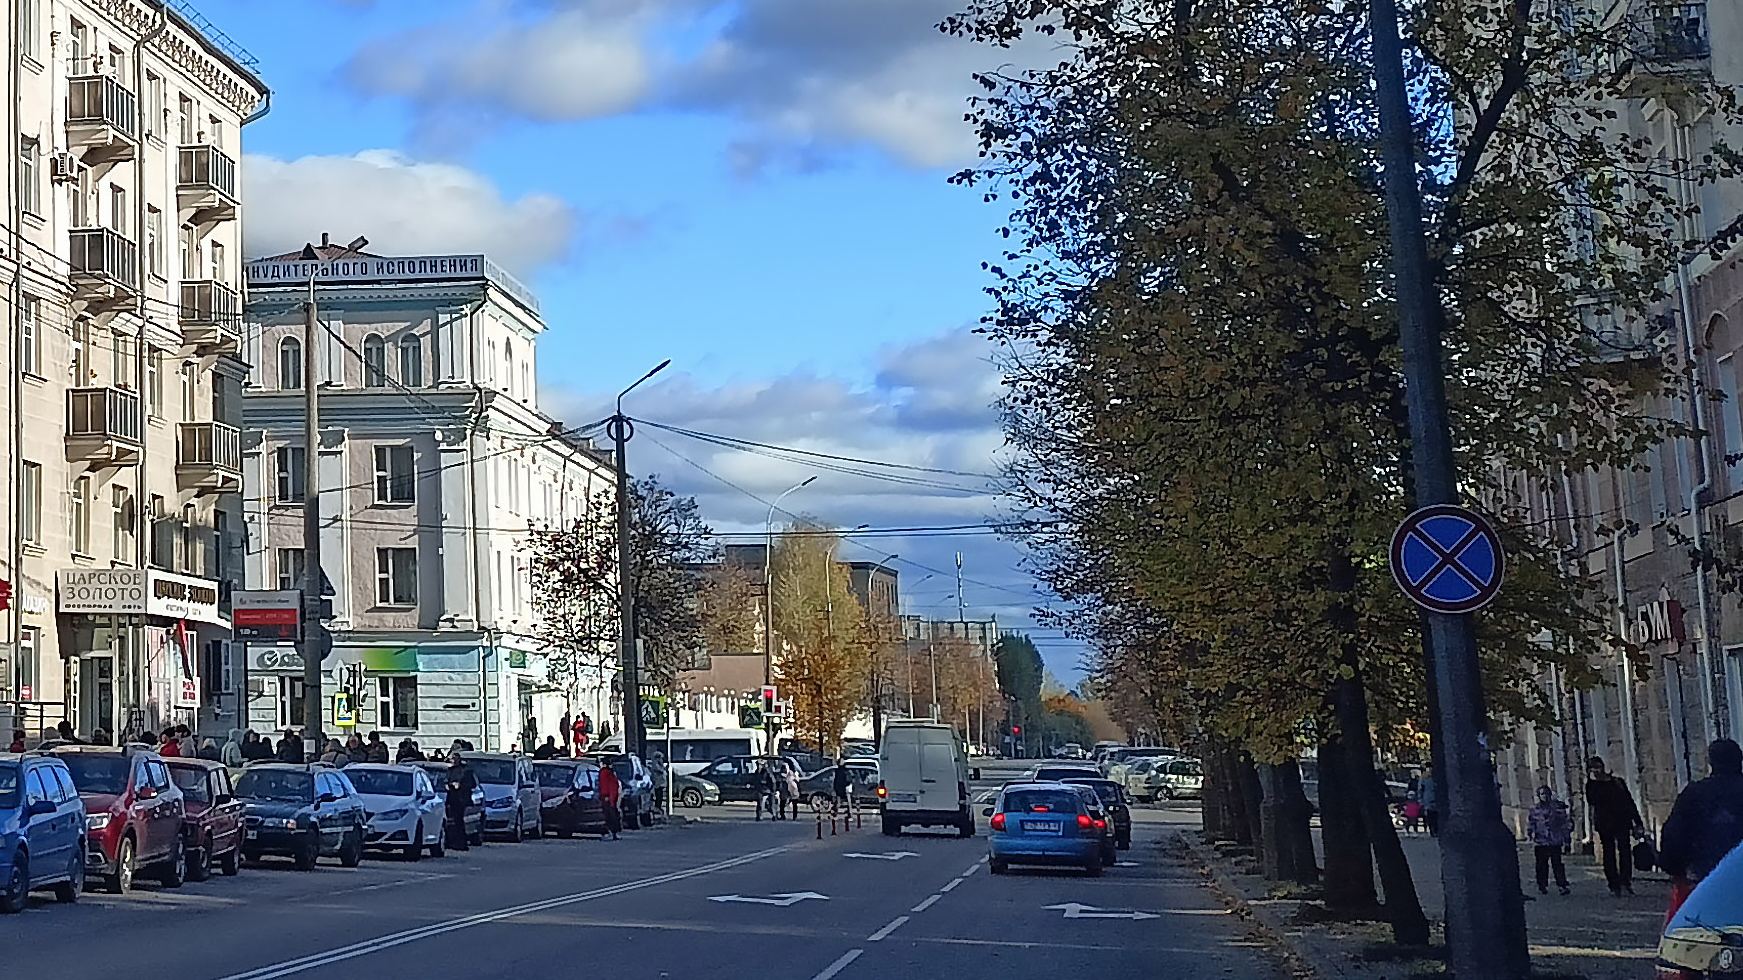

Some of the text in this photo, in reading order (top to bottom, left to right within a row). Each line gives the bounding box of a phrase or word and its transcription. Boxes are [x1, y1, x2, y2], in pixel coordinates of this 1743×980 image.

[376, 258, 478, 276] ИСПОЛНЕНИЯ
[66, 572, 142, 586] ЦАРСКОЕ
[66, 587, 142, 601] ЗОЛОТО
